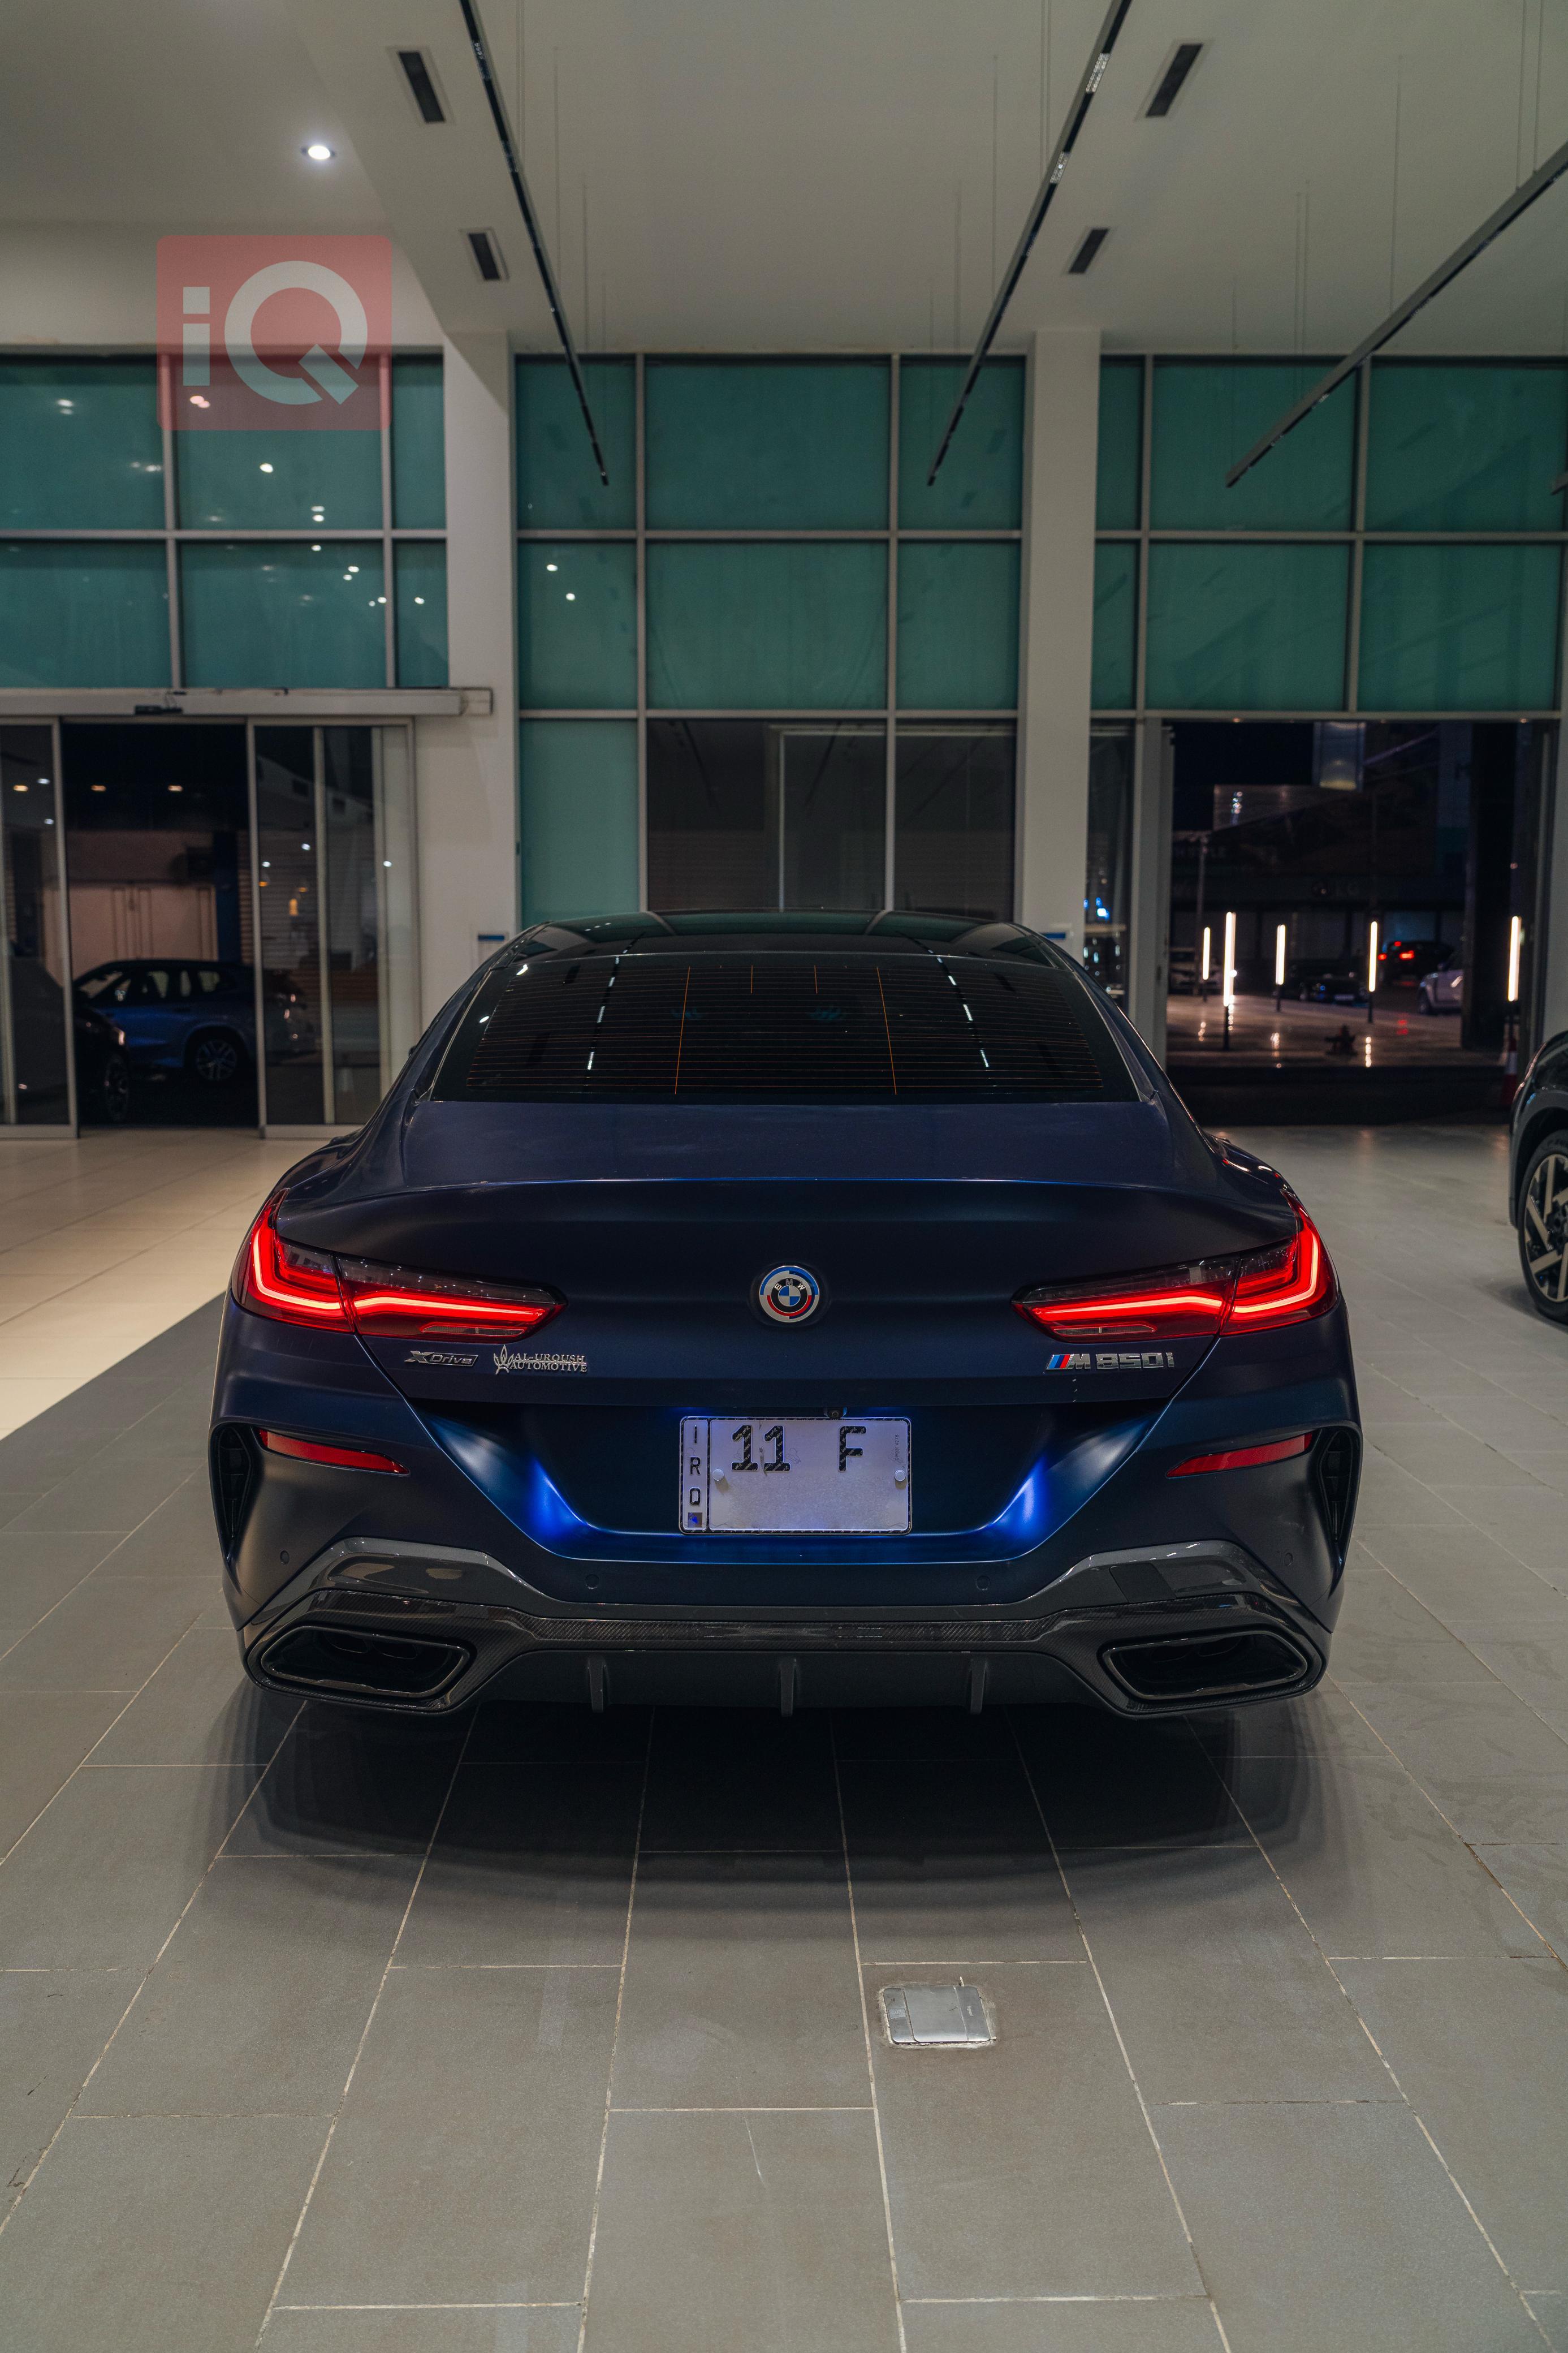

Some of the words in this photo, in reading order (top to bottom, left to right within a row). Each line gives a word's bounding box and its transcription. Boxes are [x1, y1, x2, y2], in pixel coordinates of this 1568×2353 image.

[774, 1278, 805, 1291] BMW
[515, 1353, 585, 1363] AL-UROUSH
[1067, 1352, 1174, 1369] M850i
[509, 1362, 588, 1372] AUTOMOTIVE
[731, 1425, 791, 1471] 11
[838, 1425, 867, 1471] F
